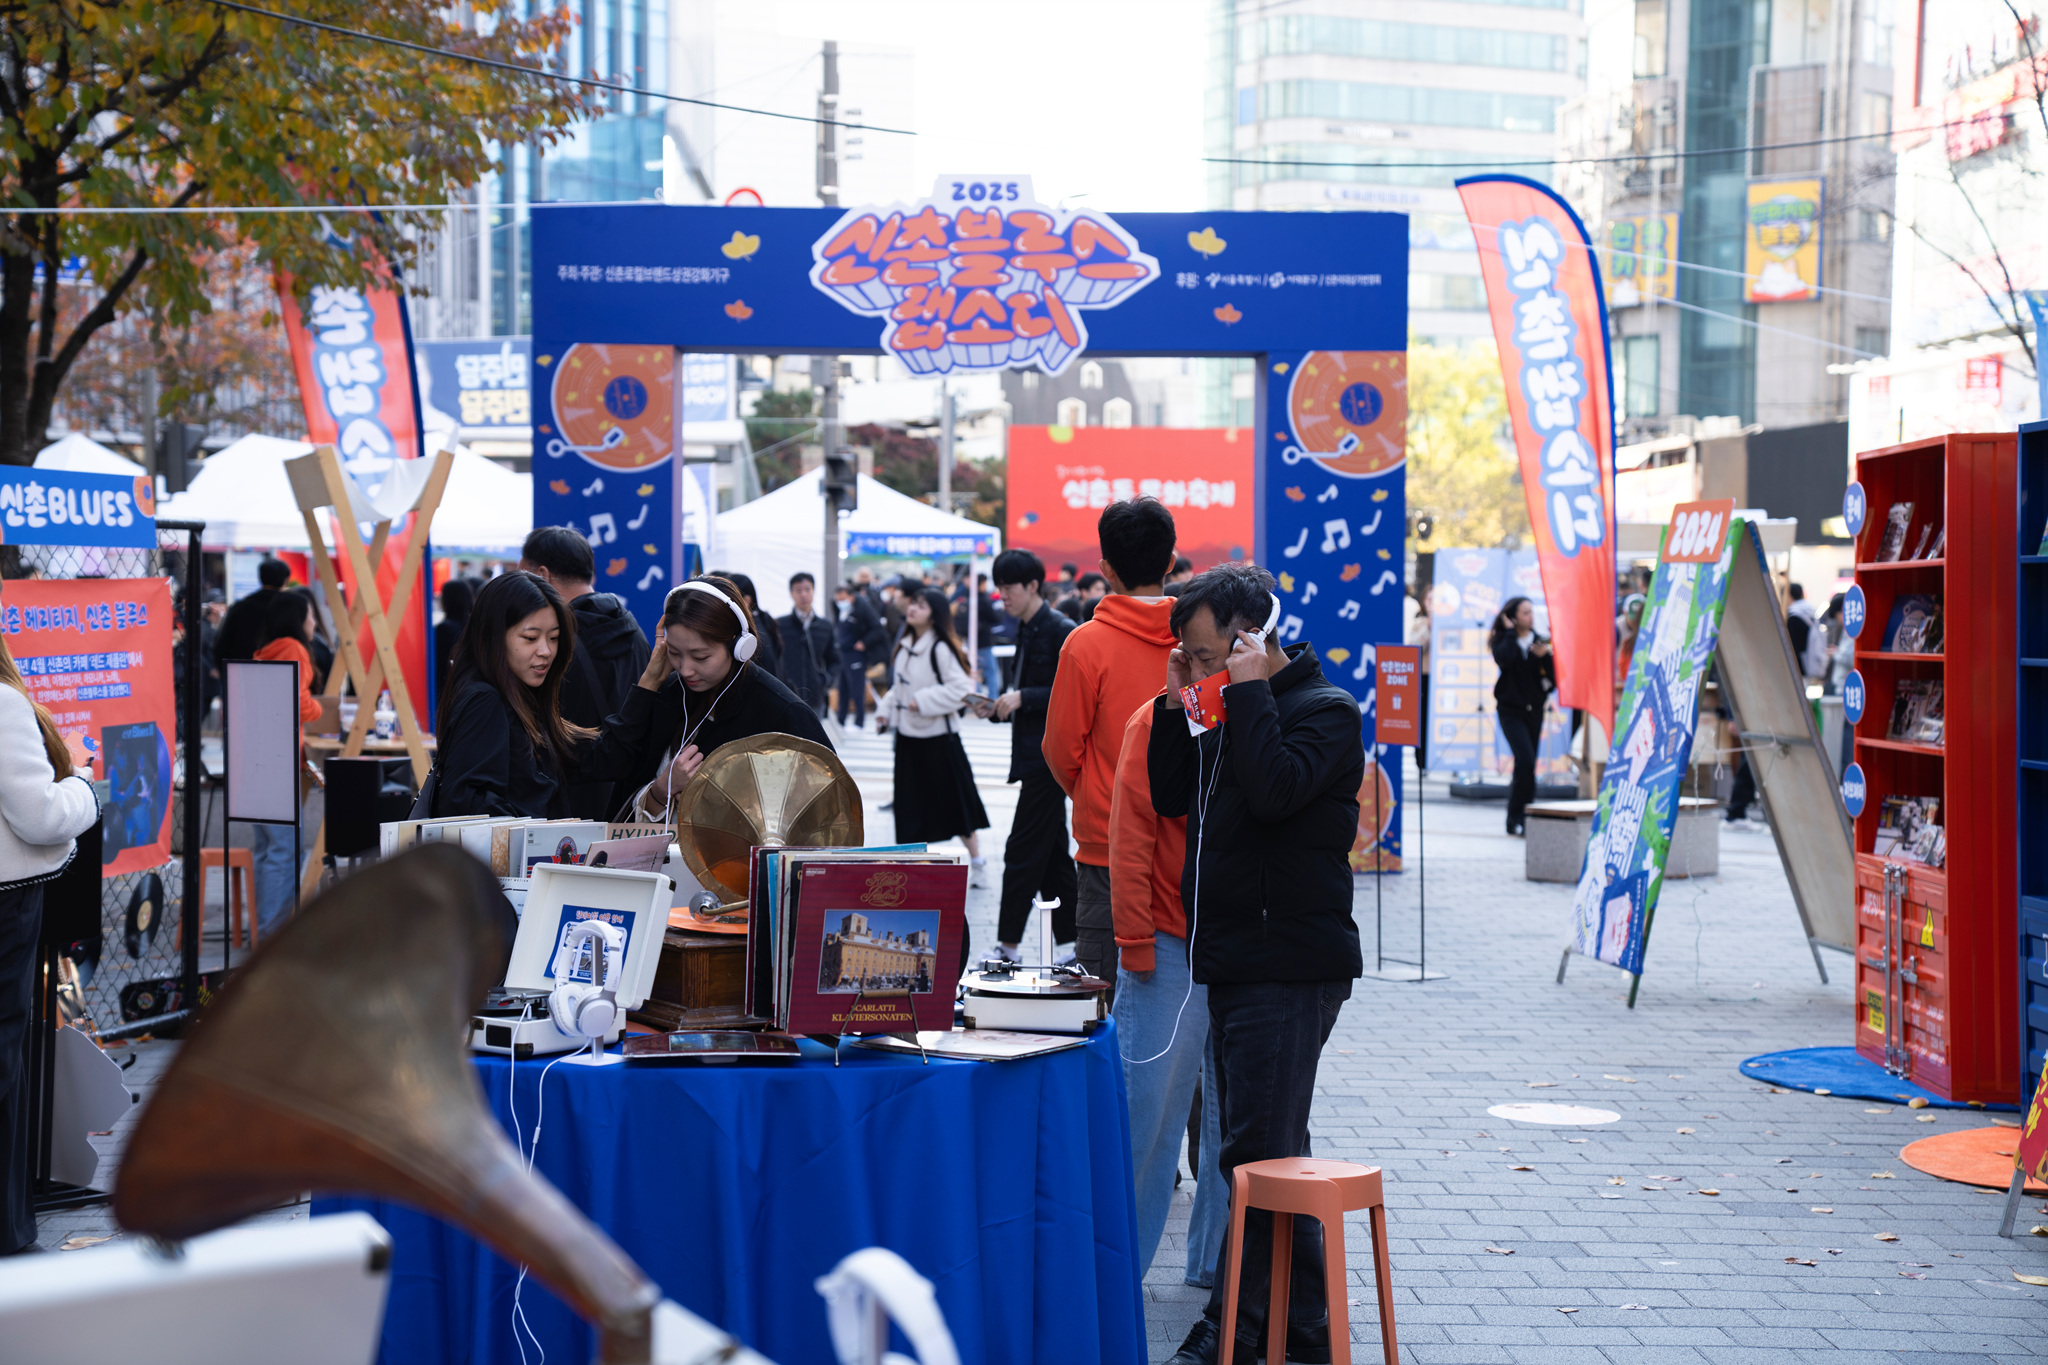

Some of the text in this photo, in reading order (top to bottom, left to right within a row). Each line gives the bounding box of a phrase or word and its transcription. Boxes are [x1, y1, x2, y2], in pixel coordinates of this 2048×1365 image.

[952, 182, 1019, 202] 2025
[820, 205, 1150, 287] 신촌블루스
[890, 285, 1080, 351] 랩소디
[0, 480, 134, 529] 신촌BLUES
[1668, 510, 1723, 557] 2024
[23, 604, 84, 635] 헤리티지,
[86, 601, 112, 632] 신촌
[114, 601, 148, 631] 블루스
[1845, 600, 1863, 626] 블루스
[30, 657, 46, 674] 4월
[47, 655, 72, 674] 신촌의
[72, 654, 89, 671] 카페
[1386, 674, 1409, 686] ZONE
